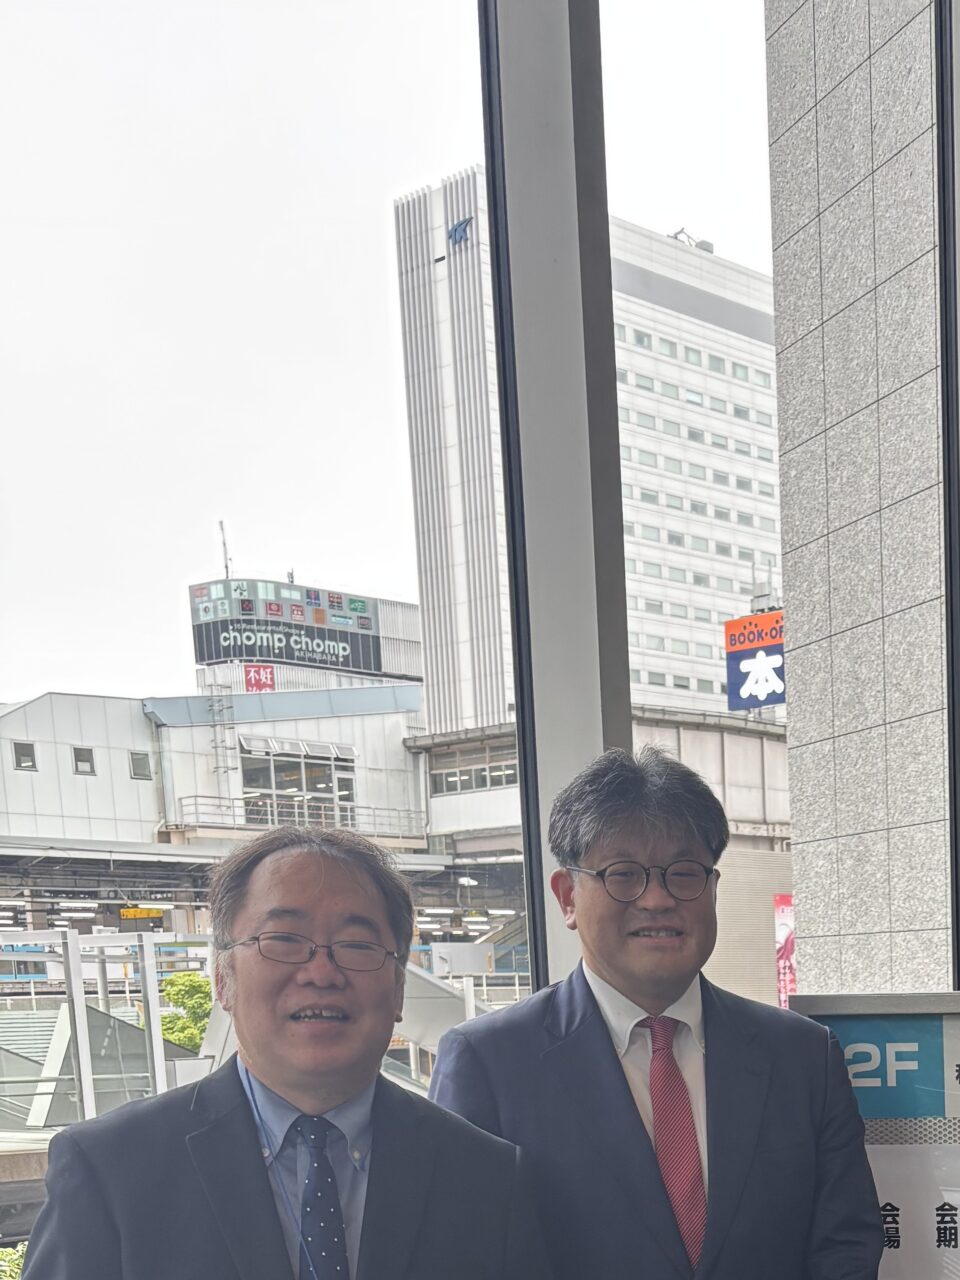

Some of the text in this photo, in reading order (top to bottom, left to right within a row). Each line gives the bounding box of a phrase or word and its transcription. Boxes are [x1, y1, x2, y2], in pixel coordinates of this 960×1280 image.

[220, 626, 350, 662] chomp chomp
[246, 667, 273, 685] 不妊
[844, 1042, 919, 1088] 2F
[935, 1202, 959, 1249] 会期
